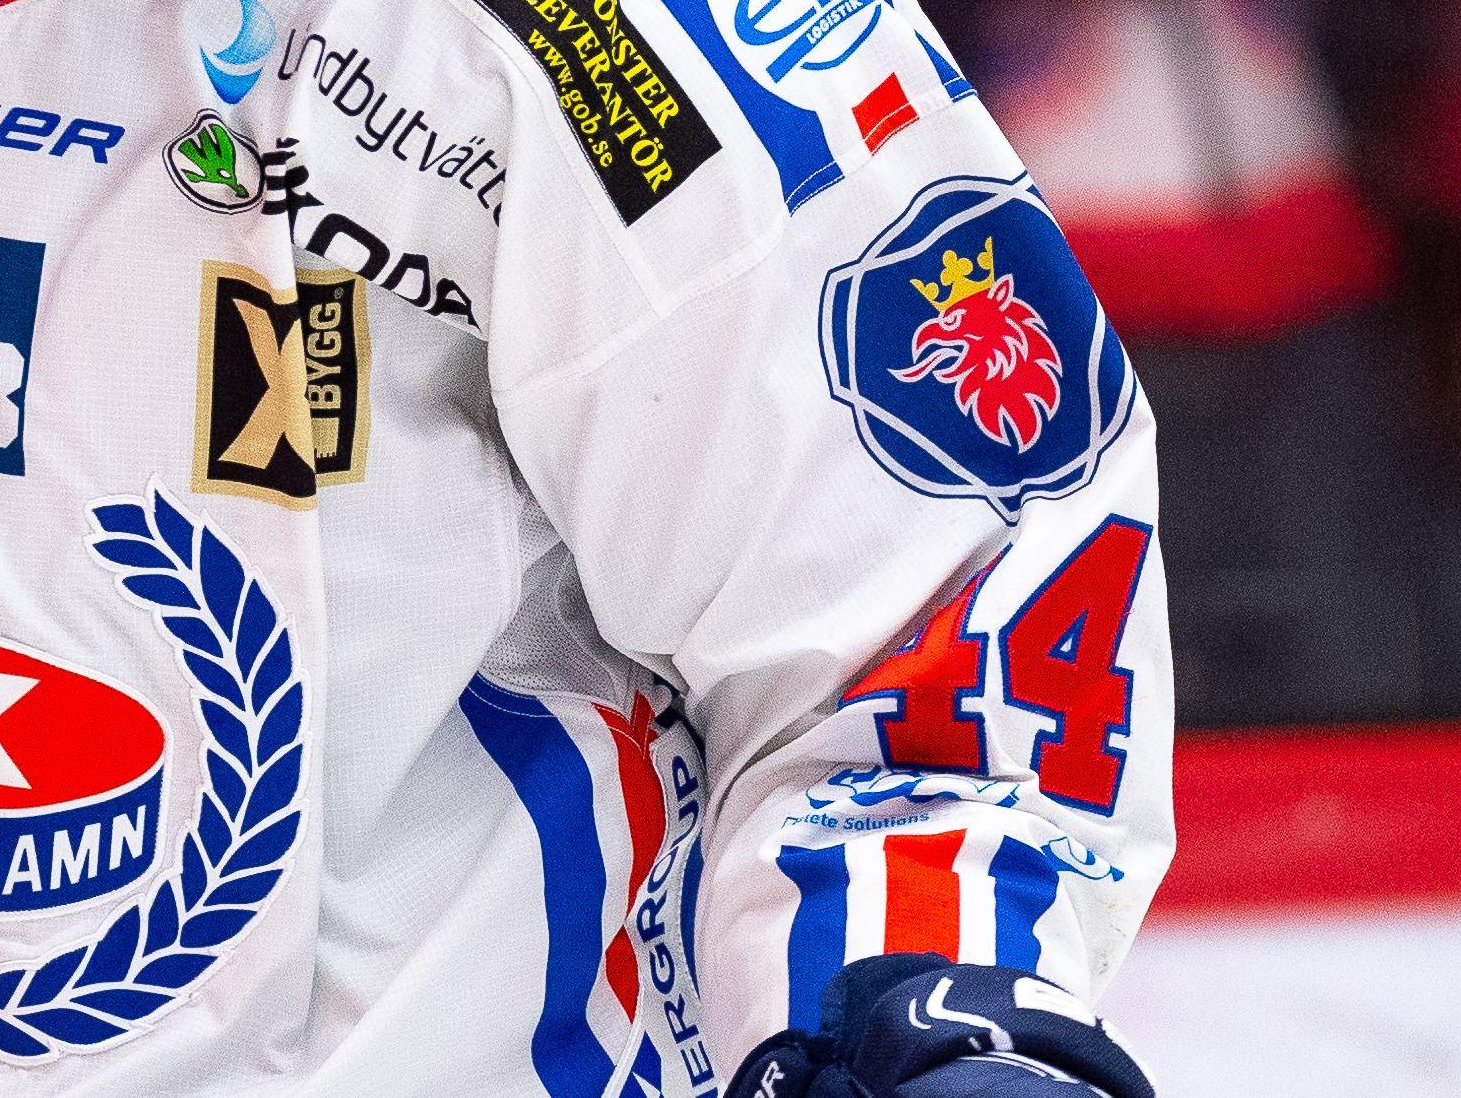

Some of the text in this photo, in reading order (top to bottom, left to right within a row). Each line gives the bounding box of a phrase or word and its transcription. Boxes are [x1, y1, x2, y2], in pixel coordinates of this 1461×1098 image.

[528, 28, 614, 169] www.gob.se
[306, 302, 343, 410] BYGG
[842, 812, 930, 831] Solutions
